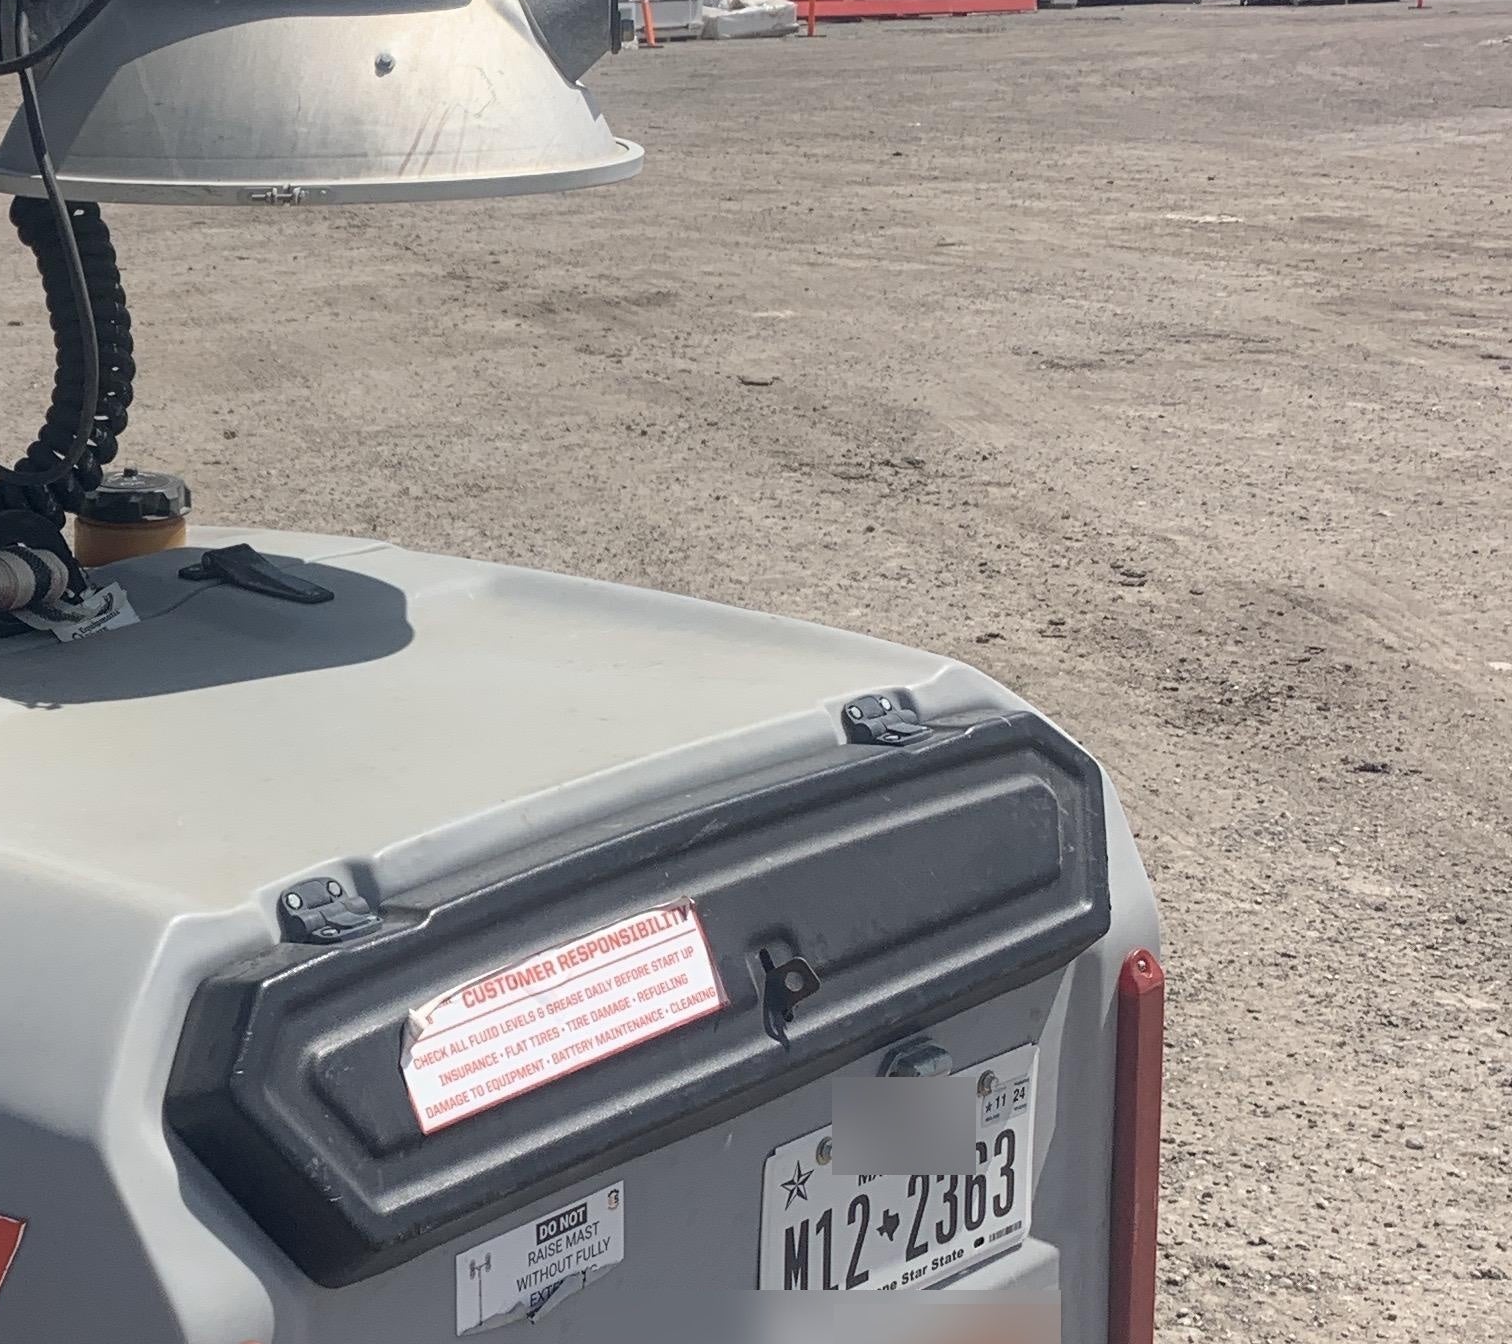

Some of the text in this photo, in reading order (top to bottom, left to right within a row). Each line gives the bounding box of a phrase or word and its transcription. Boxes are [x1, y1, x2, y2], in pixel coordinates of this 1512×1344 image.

[461, 904, 692, 1009] CUSTOMER RESPONSIBILITY
[413, 945, 694, 1071] CHECK ALL FLUID LEVELS & GREASE DAILY BEFORE START UP
[437, 973, 689, 1087] INSURANCE FLAT TIRES TIRE DAMAGE REFUELING
[424, 986, 716, 1119] DAMAGE TO EQUIPMENT BATTERY MAINTENANCE CLEANING
[995, 1093, 1007, 1110] 11
[1013, 1086, 1026, 1103] 24
[528, 1221, 600, 1267] RAISE MAST
[539, 1207, 586, 1241] DO NOT
[784, 1193, 872, 1291] M12
[516, 1254, 574, 1293] WITHOUT
[576, 1236, 611, 1265] FULLY
[901, 1264, 929, 1285] Star
[930, 1247, 965, 1271] State
